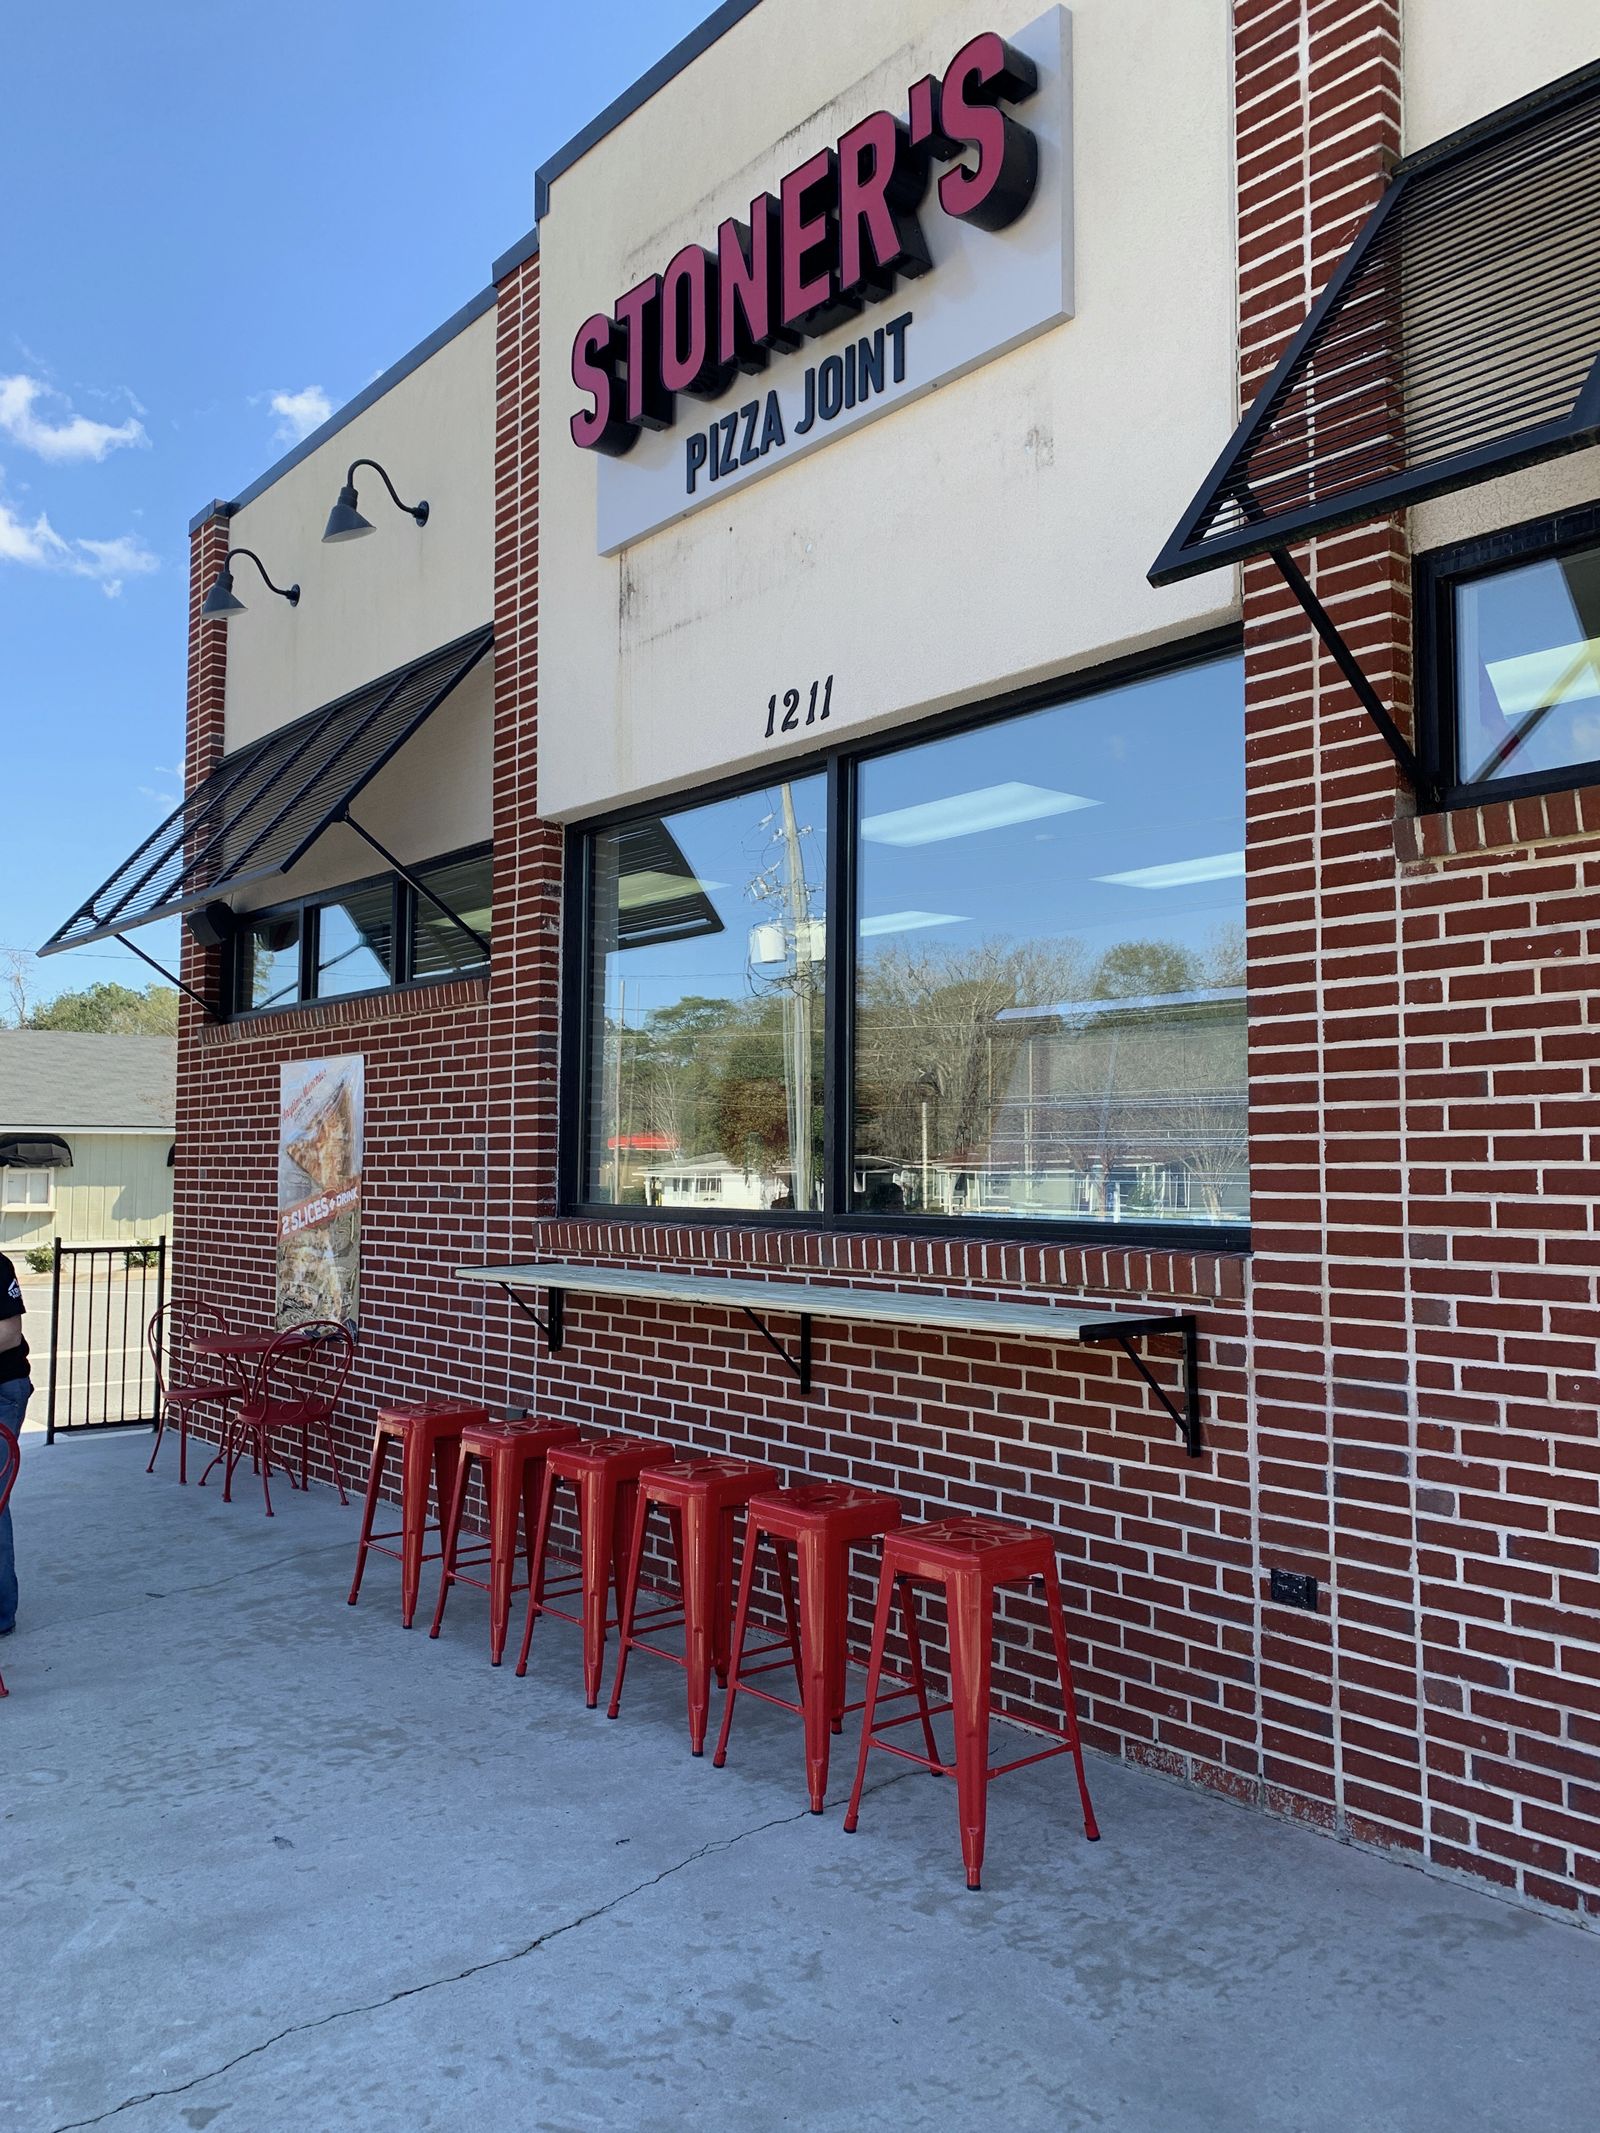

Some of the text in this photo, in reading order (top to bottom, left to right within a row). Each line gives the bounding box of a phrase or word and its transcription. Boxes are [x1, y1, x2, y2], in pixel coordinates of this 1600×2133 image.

[570, 31, 1037, 457] STONER'S
[686, 311, 913, 494] PIZZA JOINT
[765, 674, 833, 738] 1211
[282, 1215, 290, 1235] 2
[291, 1197, 330, 1231] SLICES
